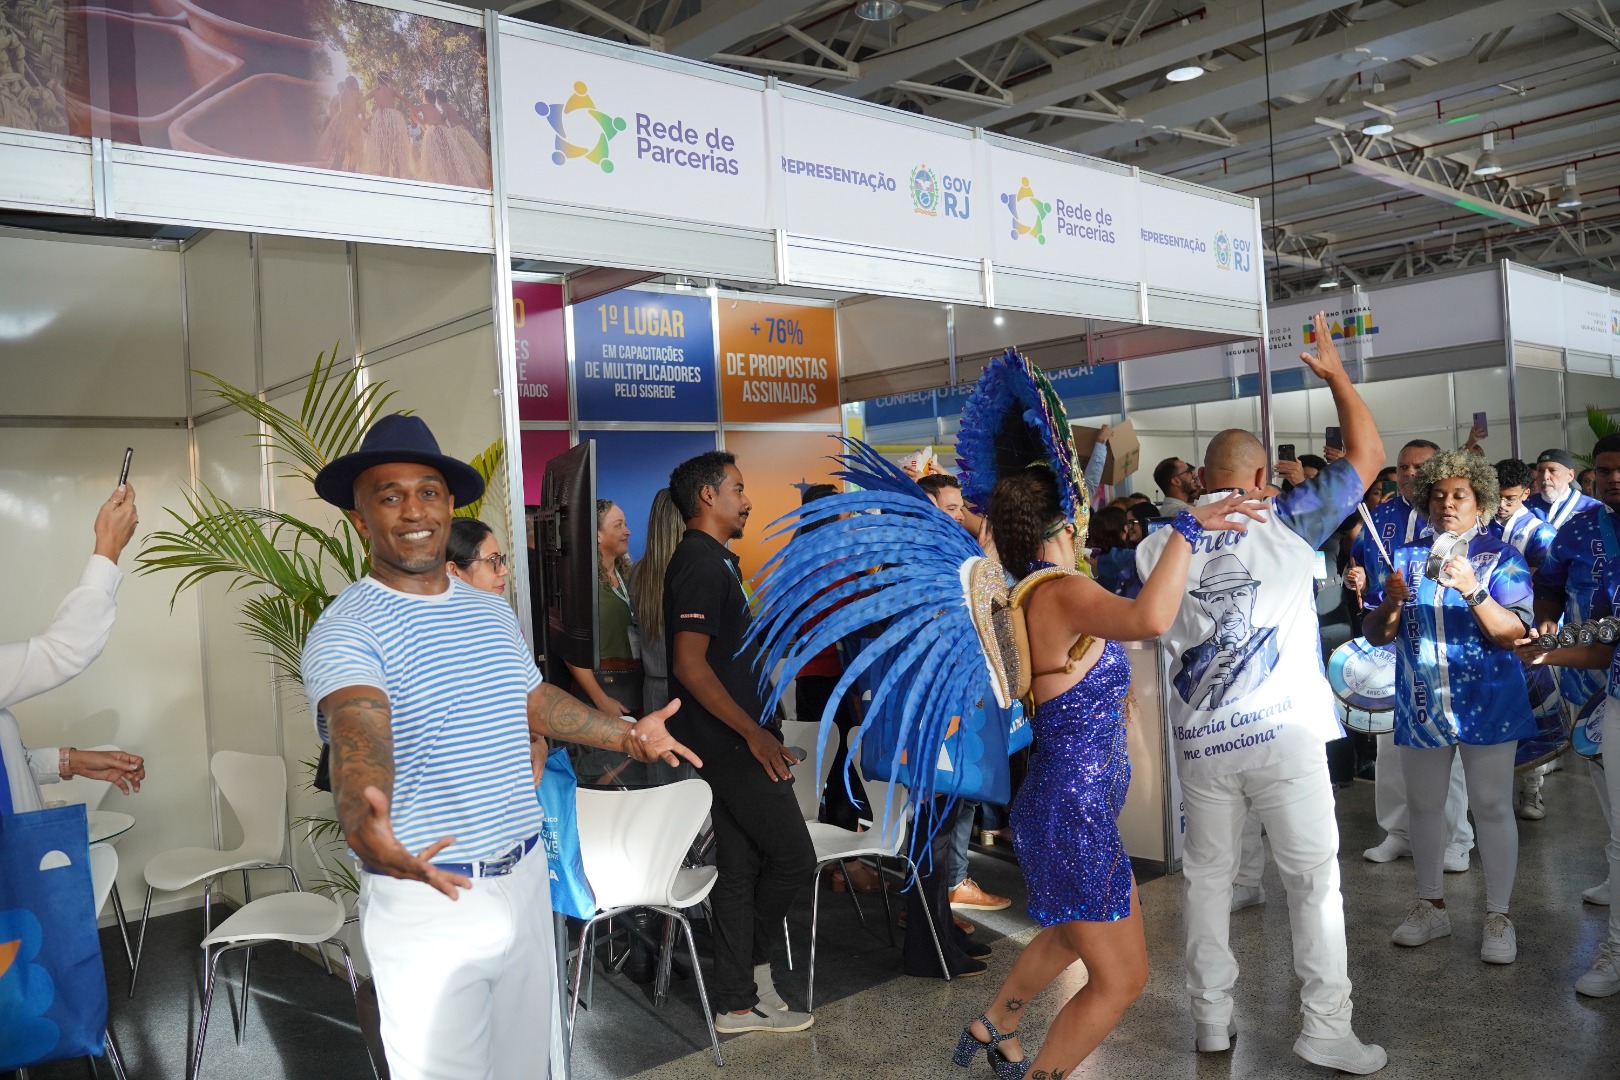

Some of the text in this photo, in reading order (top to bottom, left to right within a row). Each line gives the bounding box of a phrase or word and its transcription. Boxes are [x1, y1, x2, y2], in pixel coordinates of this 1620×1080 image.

[635, 112, 735, 151] Rede de
[636, 136, 739, 176] Parcerias
[781, 155, 897, 193] REPRESENTAÇÃO
[942, 175, 972, 195] GOV
[943, 191, 970, 220] RJ
[1056, 198, 1112, 226] Rede de
[1057, 216, 1115, 244] Parcerias
[1233, 238, 1251, 252] GOV
[1234, 251, 1250, 273] RJ
[623, 305, 685, 338] LUGAR
[1342, 306, 1372, 315] FEDERAL
[750, 317, 804, 345] + 76%
[1303, 314, 1380, 345] BASIL
[602, 343, 685, 364] EM CAPACITAÇÕES
[726, 352, 828, 380] DE PROPOSTAS
[584, 361, 702, 383] DE MULTIPLICADORES
[615, 383, 676, 399] PELO SISREDE
[742, 380, 817, 404] ASSINADAS
[1404, 560, 1426, 656] MESTRE
[1413, 670, 1428, 725] LEO
[1178, 719, 1227, 741] Bateria
[1230, 695, 1293, 729] Carcará
[1183, 749, 1202, 761] me
